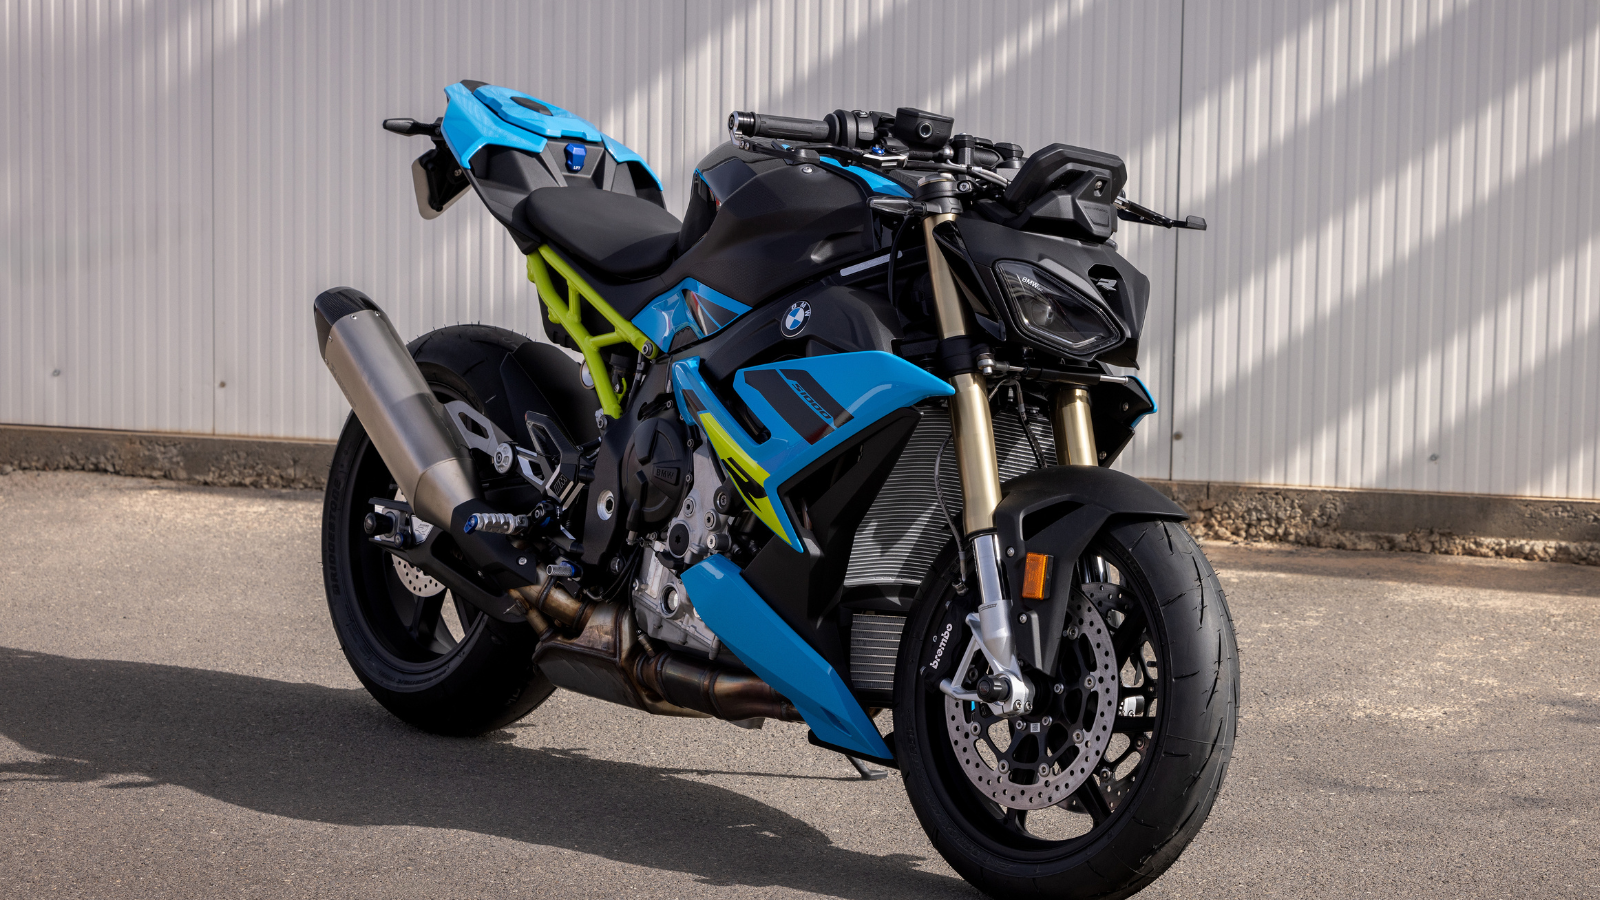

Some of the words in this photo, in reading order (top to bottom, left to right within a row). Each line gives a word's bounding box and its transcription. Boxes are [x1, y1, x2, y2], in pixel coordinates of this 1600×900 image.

[791, 301, 811, 317] BMW
[791, 383, 832, 419] S1000
[656, 468, 675, 479] BMW
[929, 623, 953, 670] brembo
